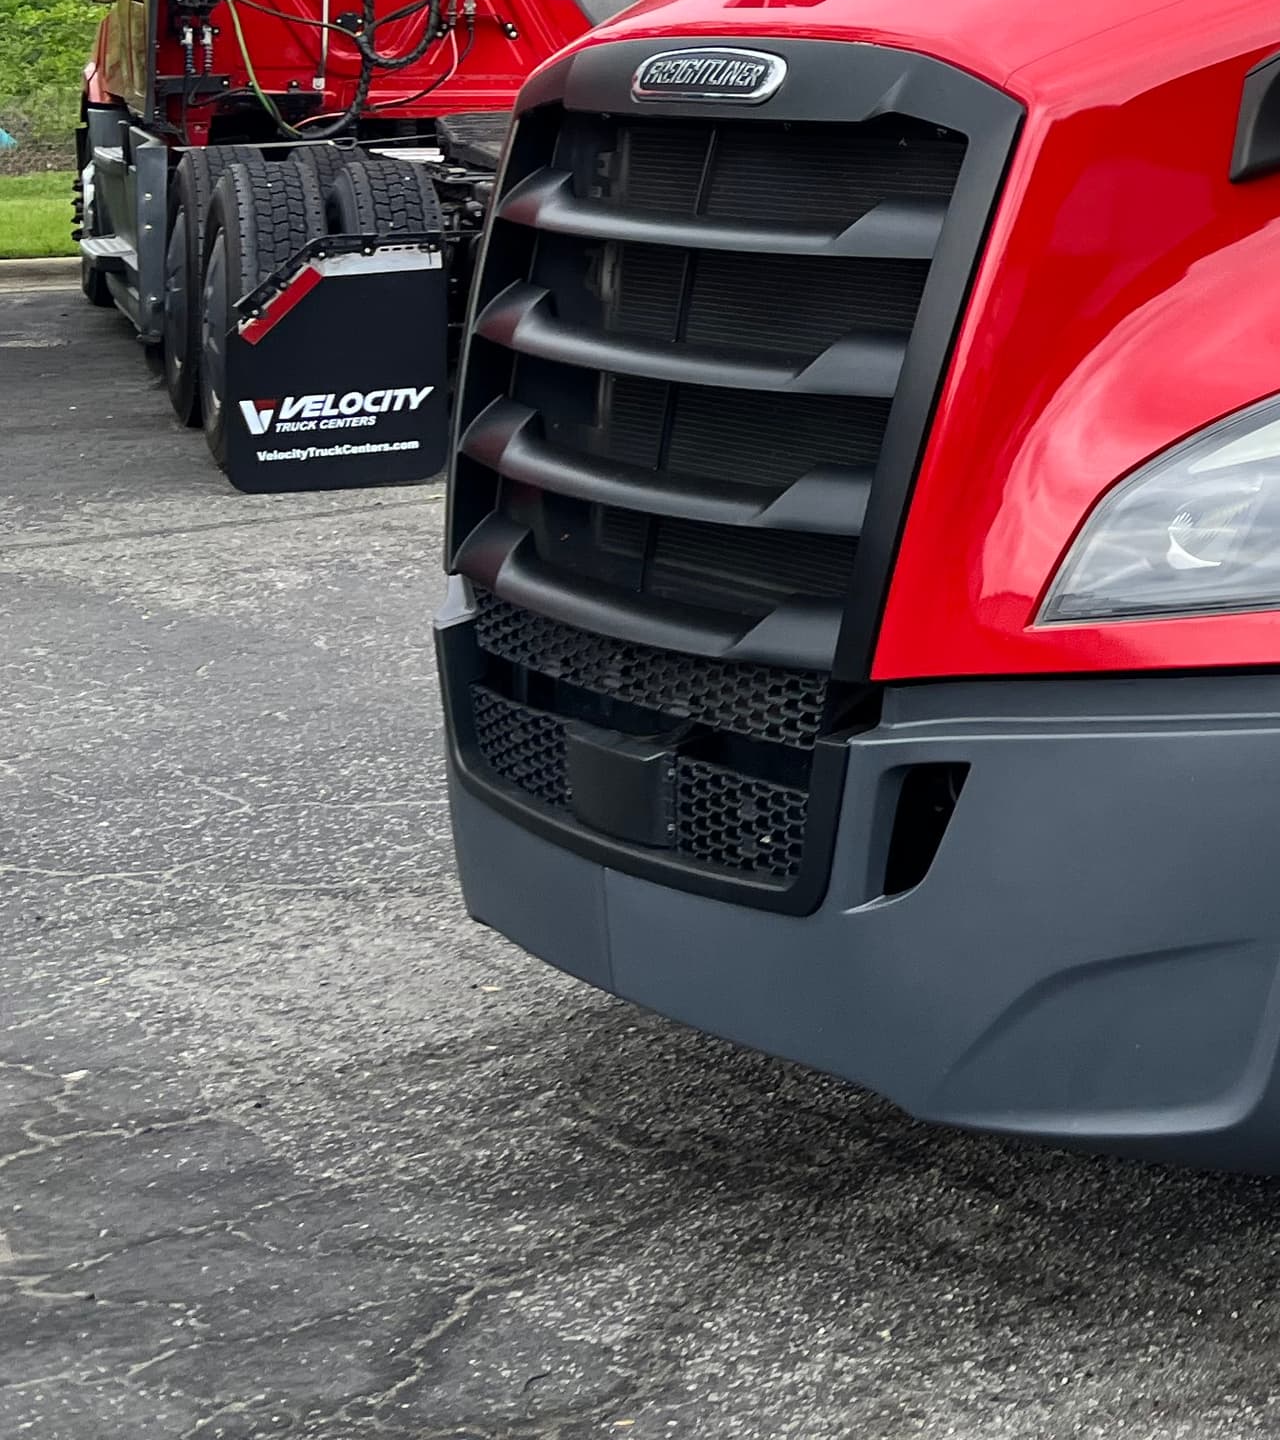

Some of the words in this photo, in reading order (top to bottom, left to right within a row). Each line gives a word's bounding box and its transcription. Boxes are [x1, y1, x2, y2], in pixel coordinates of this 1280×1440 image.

[643, 58, 766, 87] FREIGHTLINER
[278, 386, 434, 420] VELOCITY
[275, 420, 317, 433] TRUCK
[319, 415, 376, 431] CENTERS
[256, 440, 420, 461] VelocityTruckCenters.com
